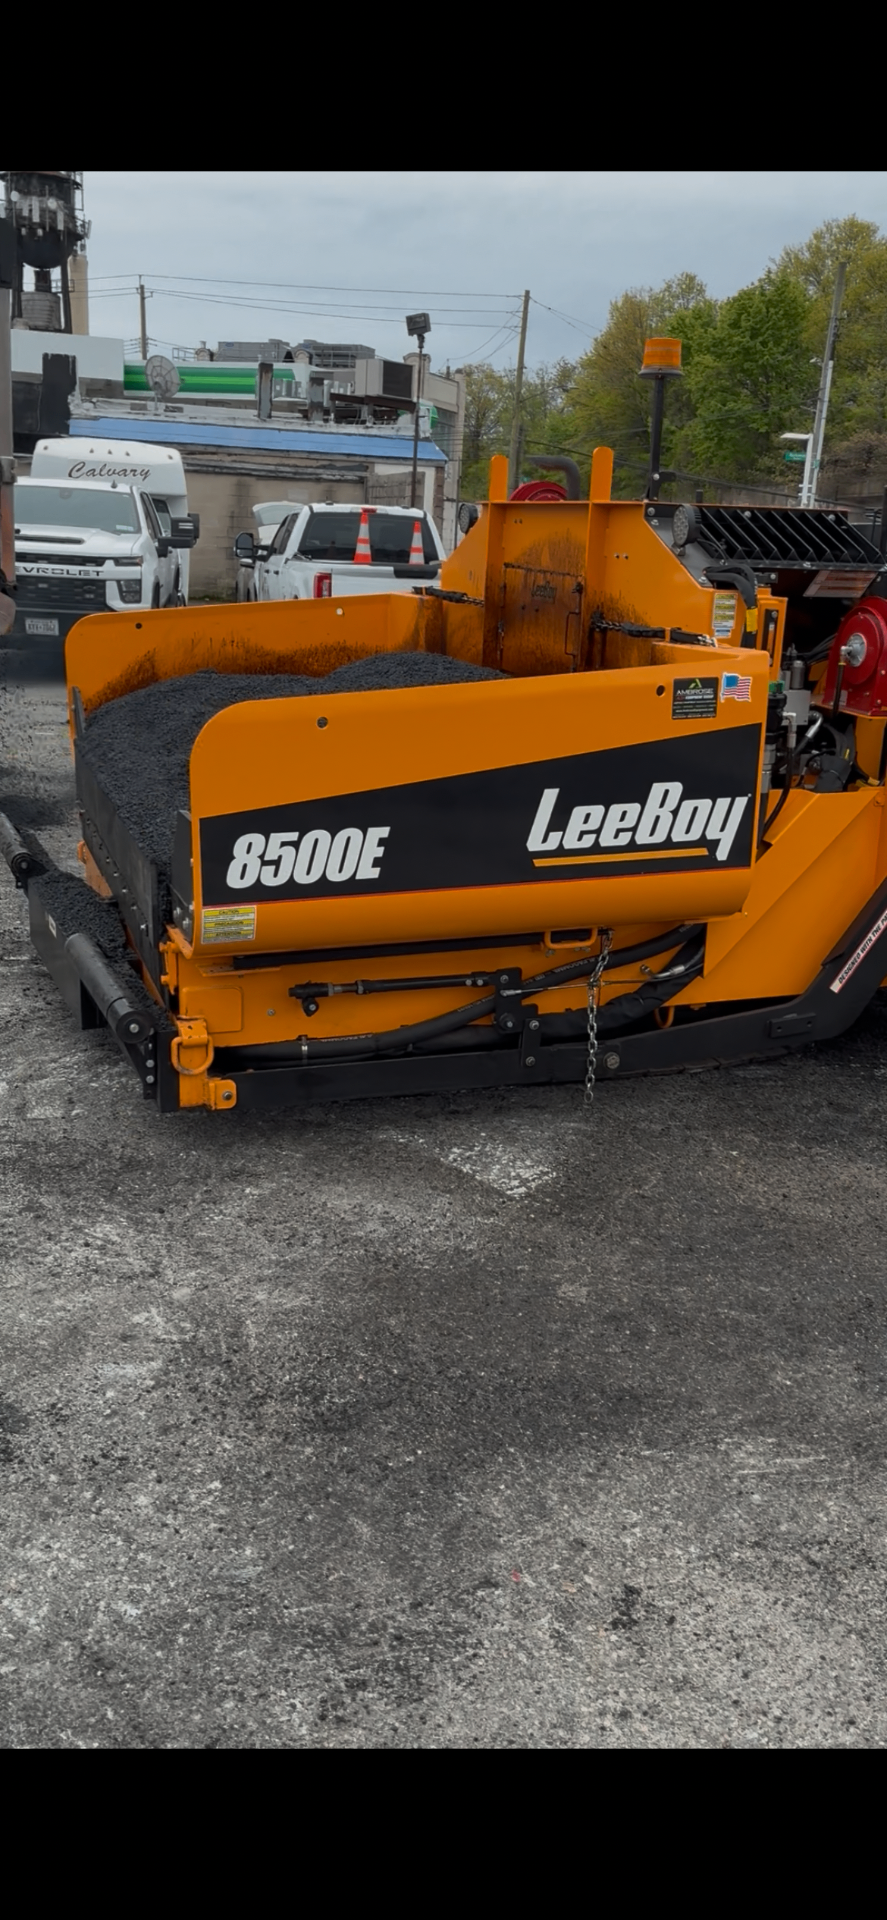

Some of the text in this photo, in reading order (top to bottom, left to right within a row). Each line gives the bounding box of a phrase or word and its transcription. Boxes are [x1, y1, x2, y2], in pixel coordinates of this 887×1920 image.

[68, 461, 151, 481] Calvary
[676, 687, 714, 696] AMBROSE
[526, 781, 749, 861] LeeBoy
[226, 826, 391, 889] 8500E
[838, 952, 861, 984] DESIGNED
[860, 936, 873, 954] WITH
[872, 925, 882, 938] THE
